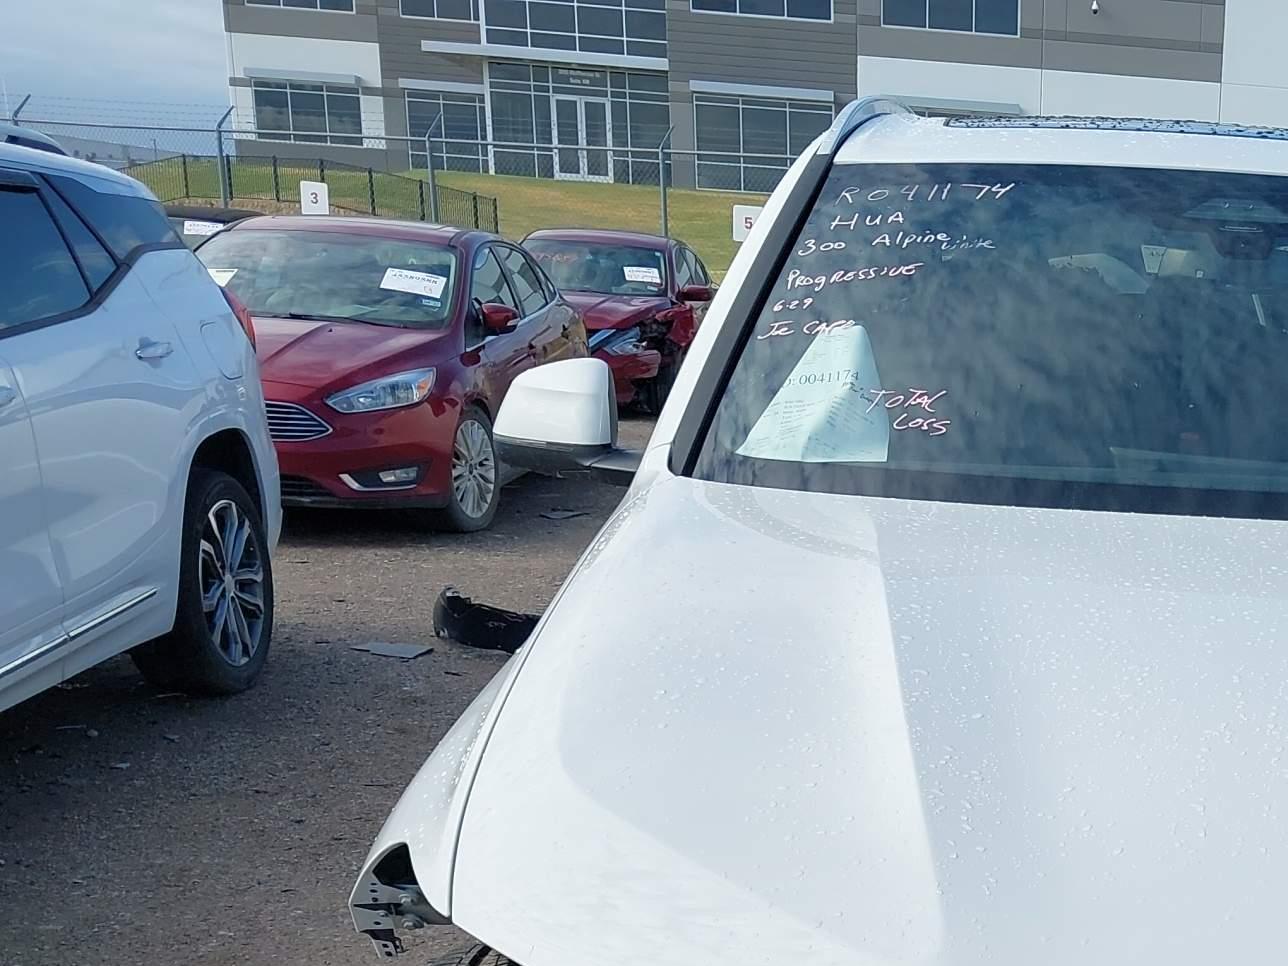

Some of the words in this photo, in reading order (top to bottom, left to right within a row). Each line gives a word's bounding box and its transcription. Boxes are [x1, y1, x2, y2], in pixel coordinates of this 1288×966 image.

[310, 192, 319, 204] 3
[744, 217, 753, 229] 5
[798, 239, 846, 256] 300
[871, 230, 951, 249] Alpine
[798, 369, 859, 385] 0041174
[866, 388, 947, 413] TOTAL
